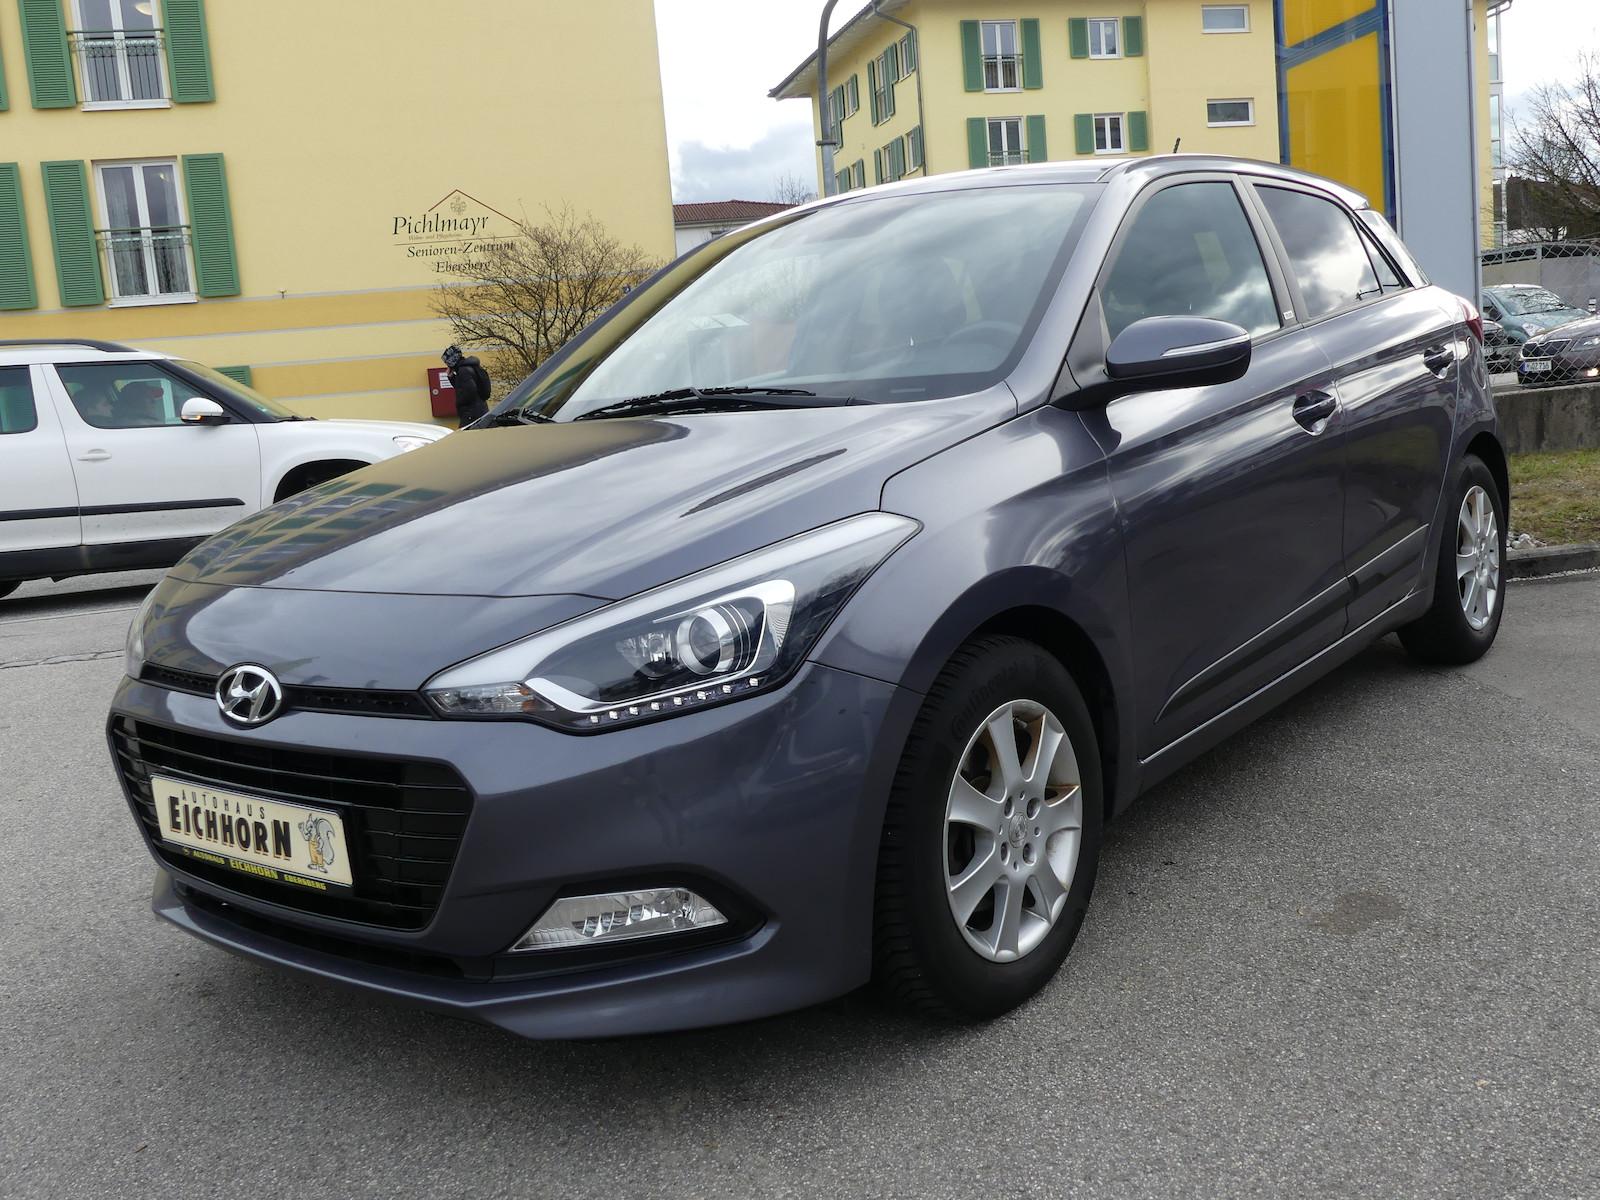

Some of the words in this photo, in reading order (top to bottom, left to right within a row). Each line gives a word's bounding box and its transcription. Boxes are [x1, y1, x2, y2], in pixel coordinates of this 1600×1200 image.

[392, 212, 489, 235] Pichlmayr
[406, 241, 517, 258] Senioren-Zentrum
[435, 259, 492, 273] Ebersberg
[181, 789, 265, 820] AUTOHAUS
[168, 795, 293, 861] EICHHORN
[193, 850, 225, 865] AUTOHAUS
[230, 859, 279, 880] EICHHORN
[284, 874, 327, 891] EBERSBERG
